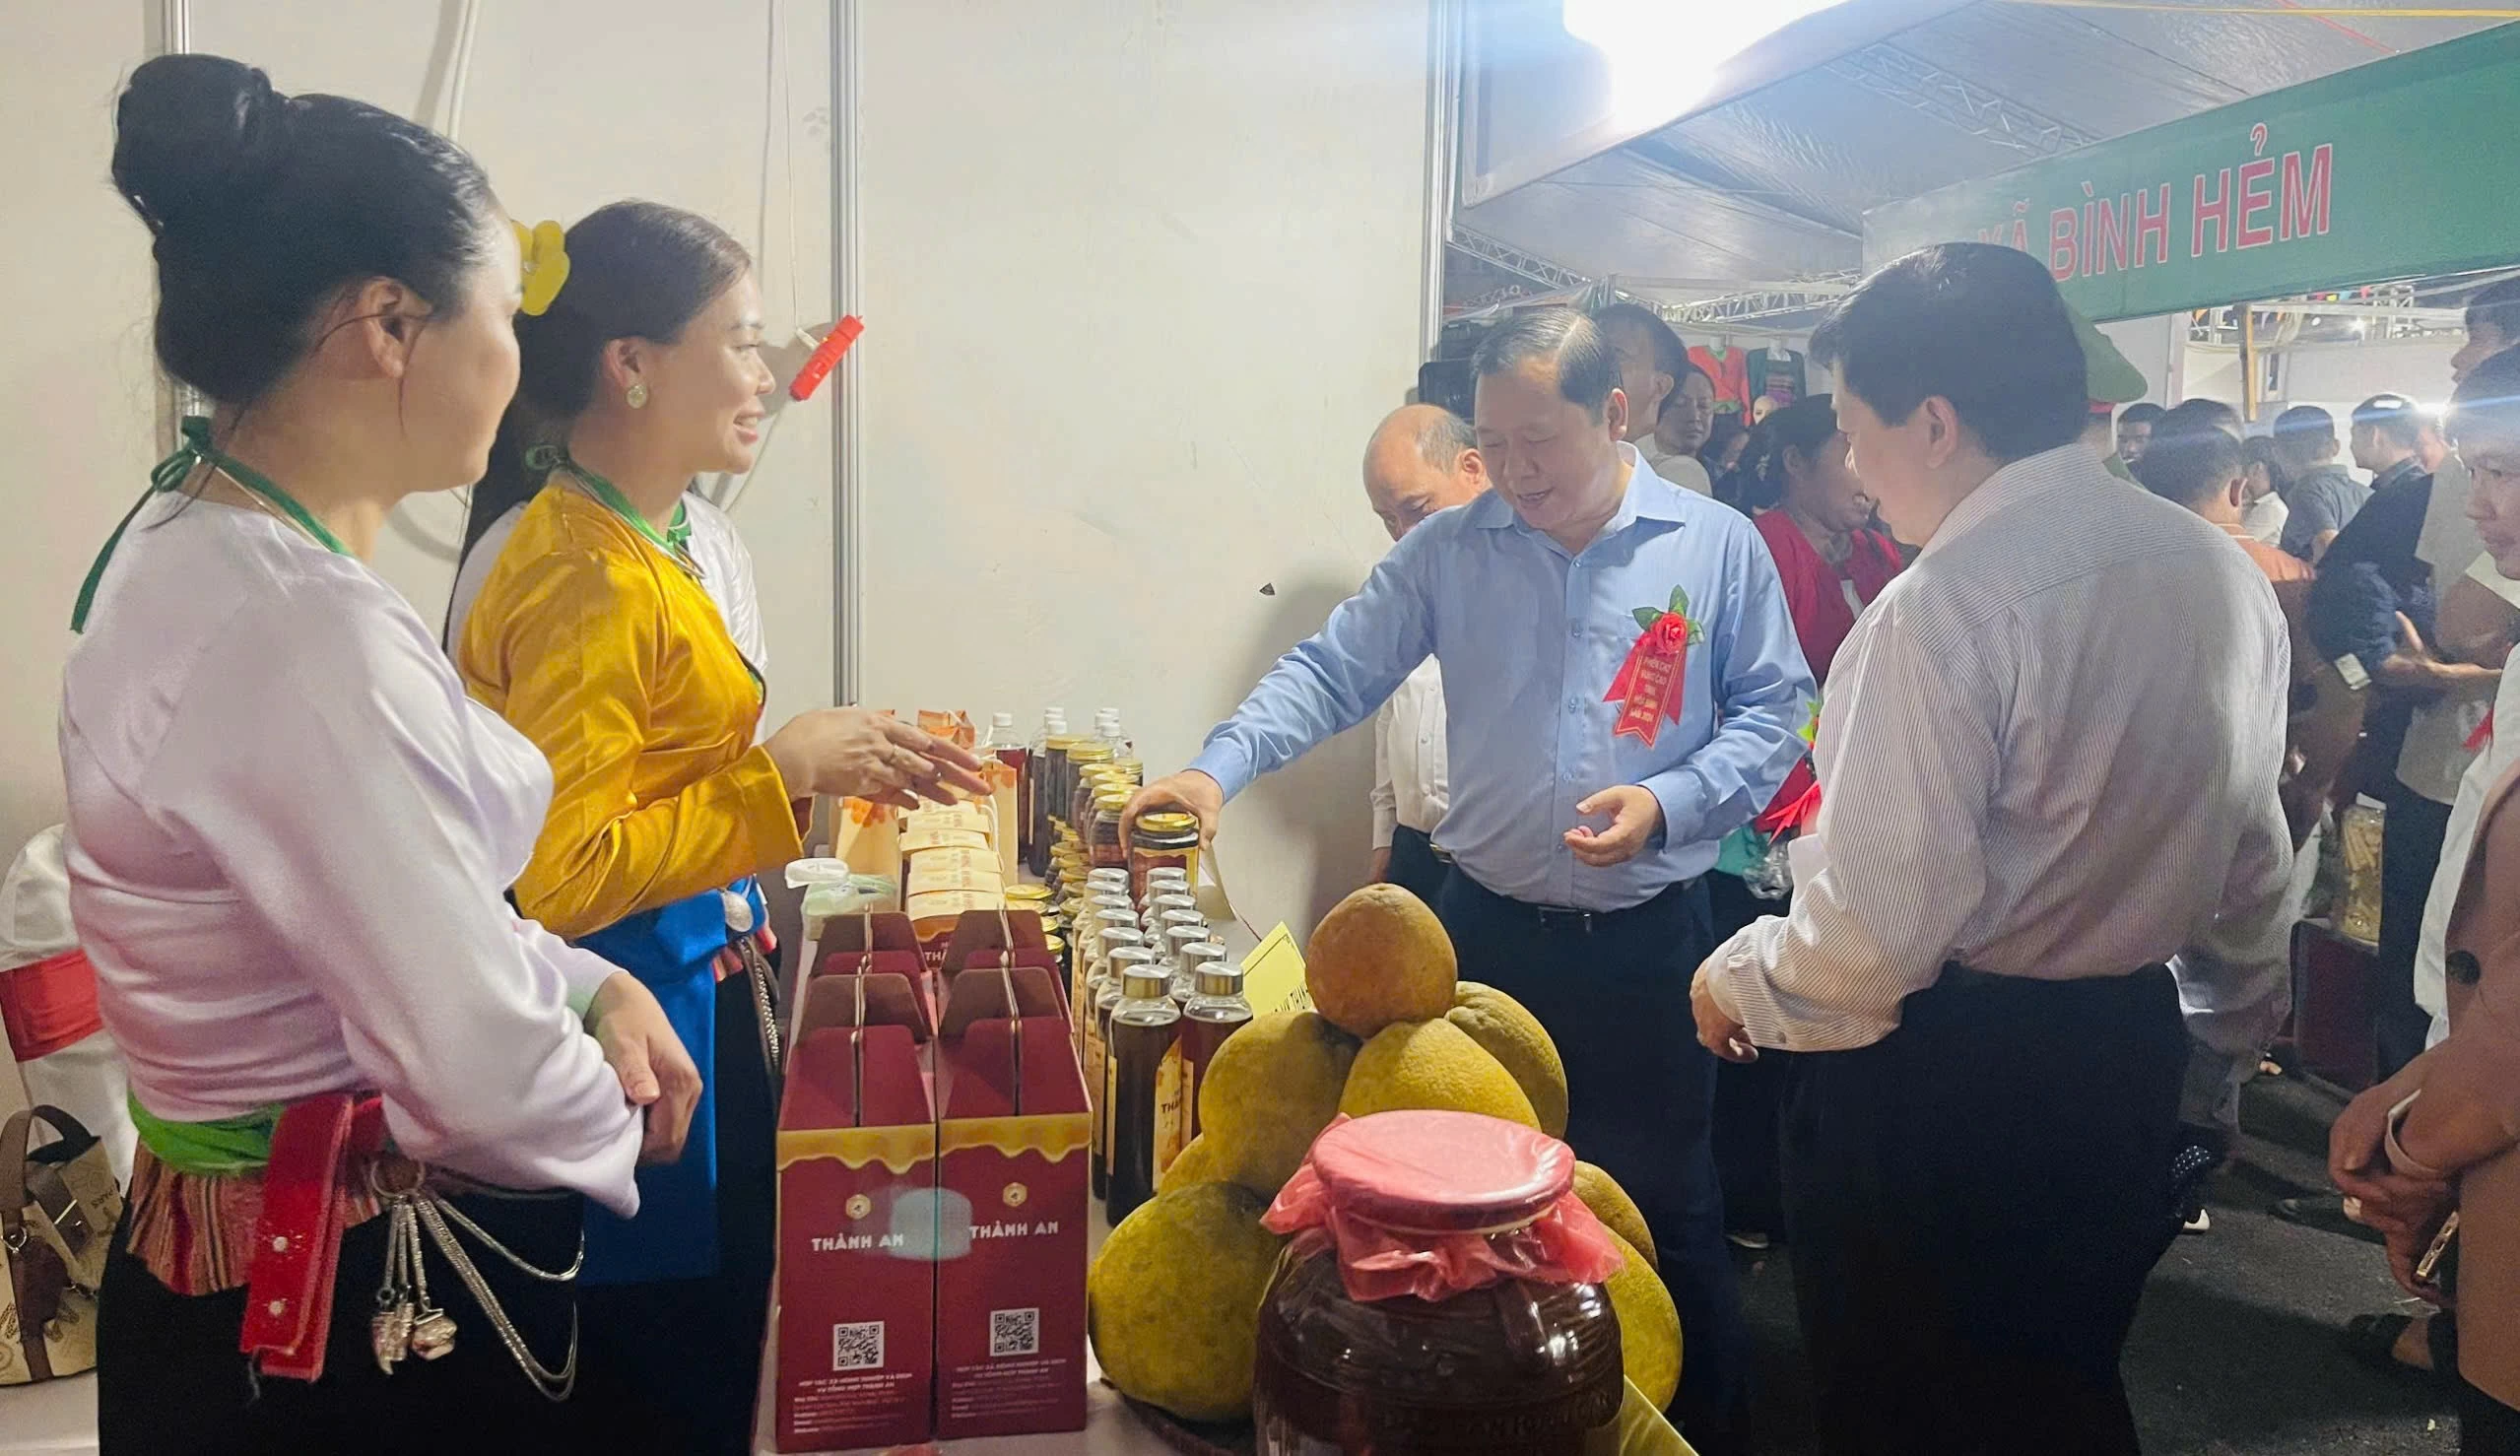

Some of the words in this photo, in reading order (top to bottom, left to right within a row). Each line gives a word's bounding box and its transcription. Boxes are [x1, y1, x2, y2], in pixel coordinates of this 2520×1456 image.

[2050, 181, 2171, 282] BÌNH
[2191, 122, 2334, 258] HẺM
[1034, 1222, 1059, 1234] AN
[879, 1233, 903, 1248] AN
